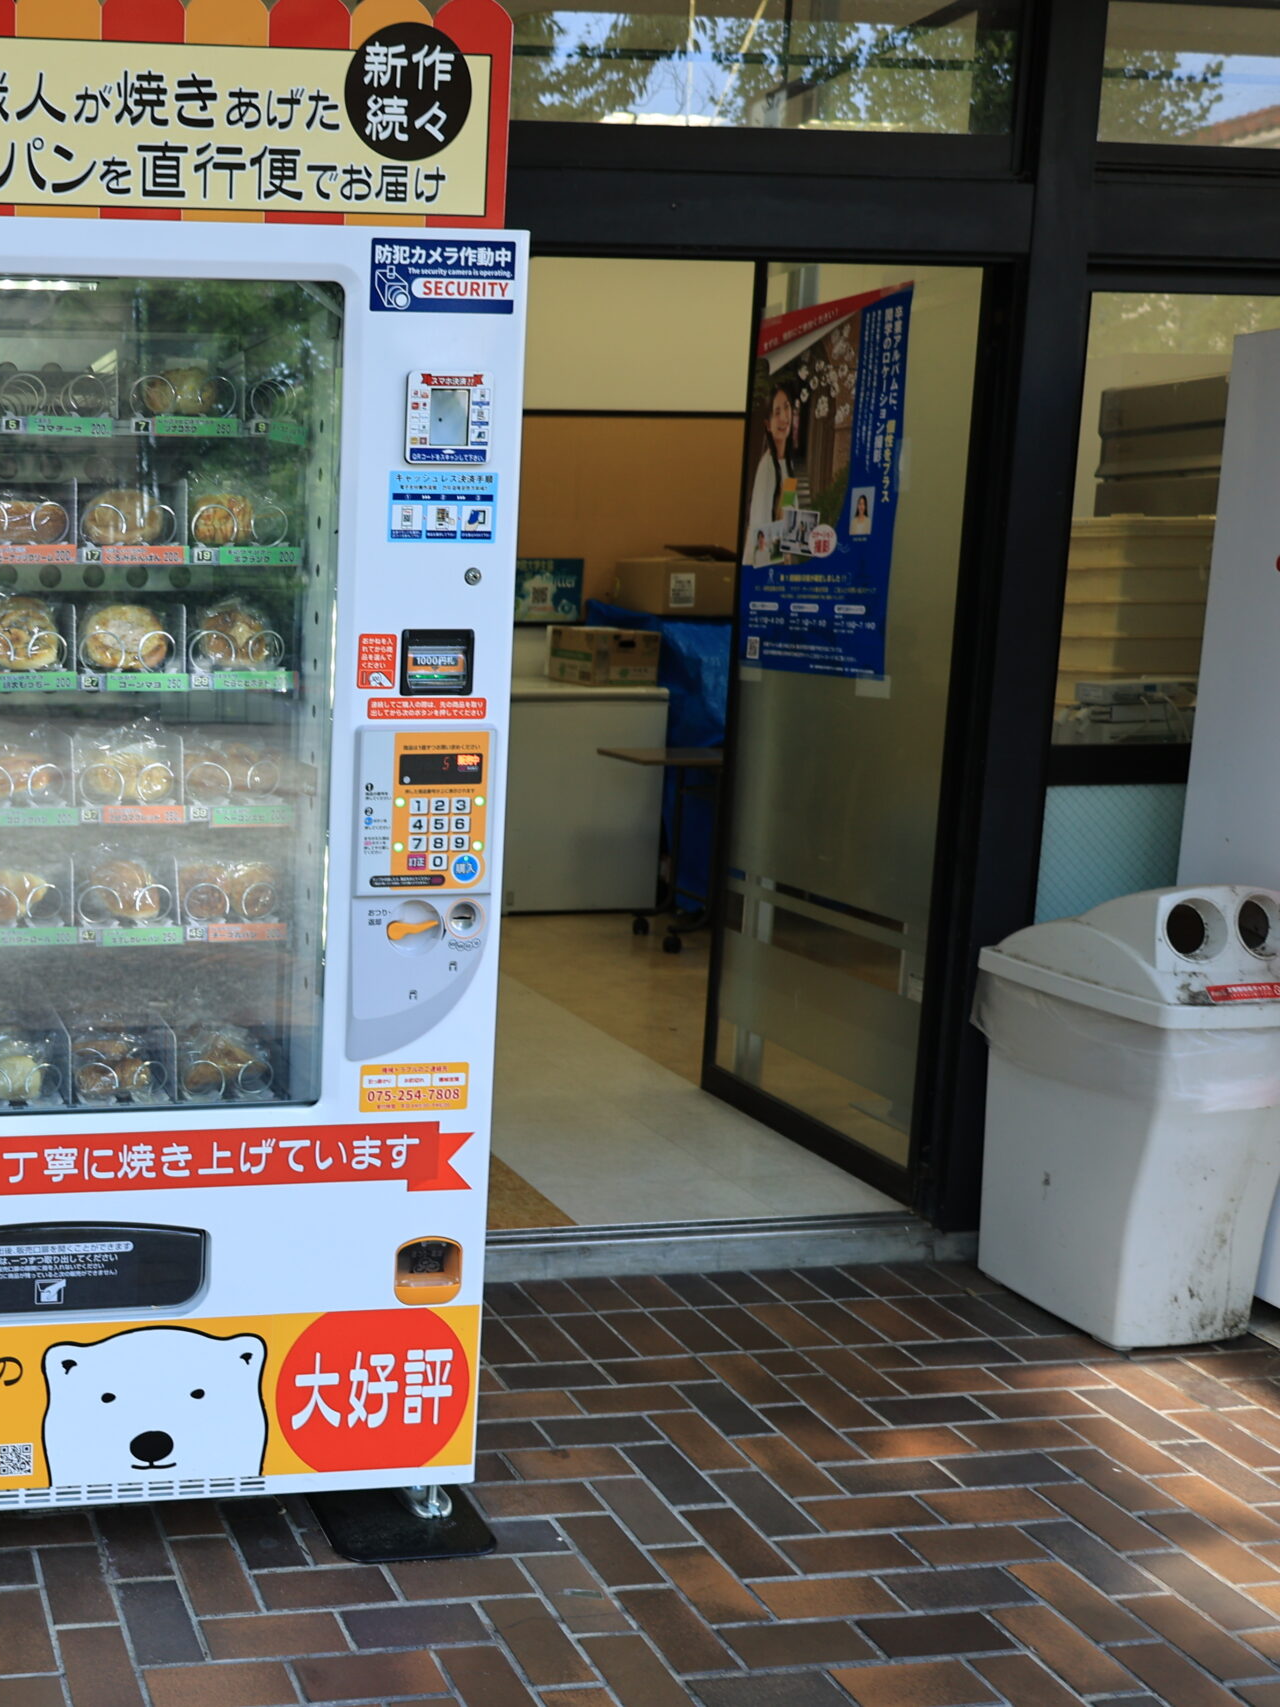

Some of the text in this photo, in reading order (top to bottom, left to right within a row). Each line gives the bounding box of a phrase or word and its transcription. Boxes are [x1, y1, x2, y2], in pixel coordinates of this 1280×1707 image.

[362, 43, 456, 91] 新作
[364, 99, 451, 144] 続々
[374, 244, 513, 268] 防犯カメラ作動中
[408, 267, 420, 275] The
[421, 268, 447, 277] security
[479, 270, 513, 278] operating.
[422, 280, 510, 298] SECURITY
[361, 661, 387, 669] ください
[416, 656, 456, 666] 1000円札
[415, 800, 421, 812] 1
[434, 800, 445, 812] 2
[455, 799, 466, 811] 3
[412, 819, 423, 831] 4
[433, 819, 444, 831] 5
[454, 818, 465, 830] 6
[412, 838, 422, 849] 7
[433, 837, 444, 849] 8
[454, 837, 465, 849] 9
[432, 856, 443, 868] 0
[455, 862, 477, 875] 購入
[367, 1088, 460, 1102] 075-254-7808
[291, 1348, 454, 1429] 大好評
